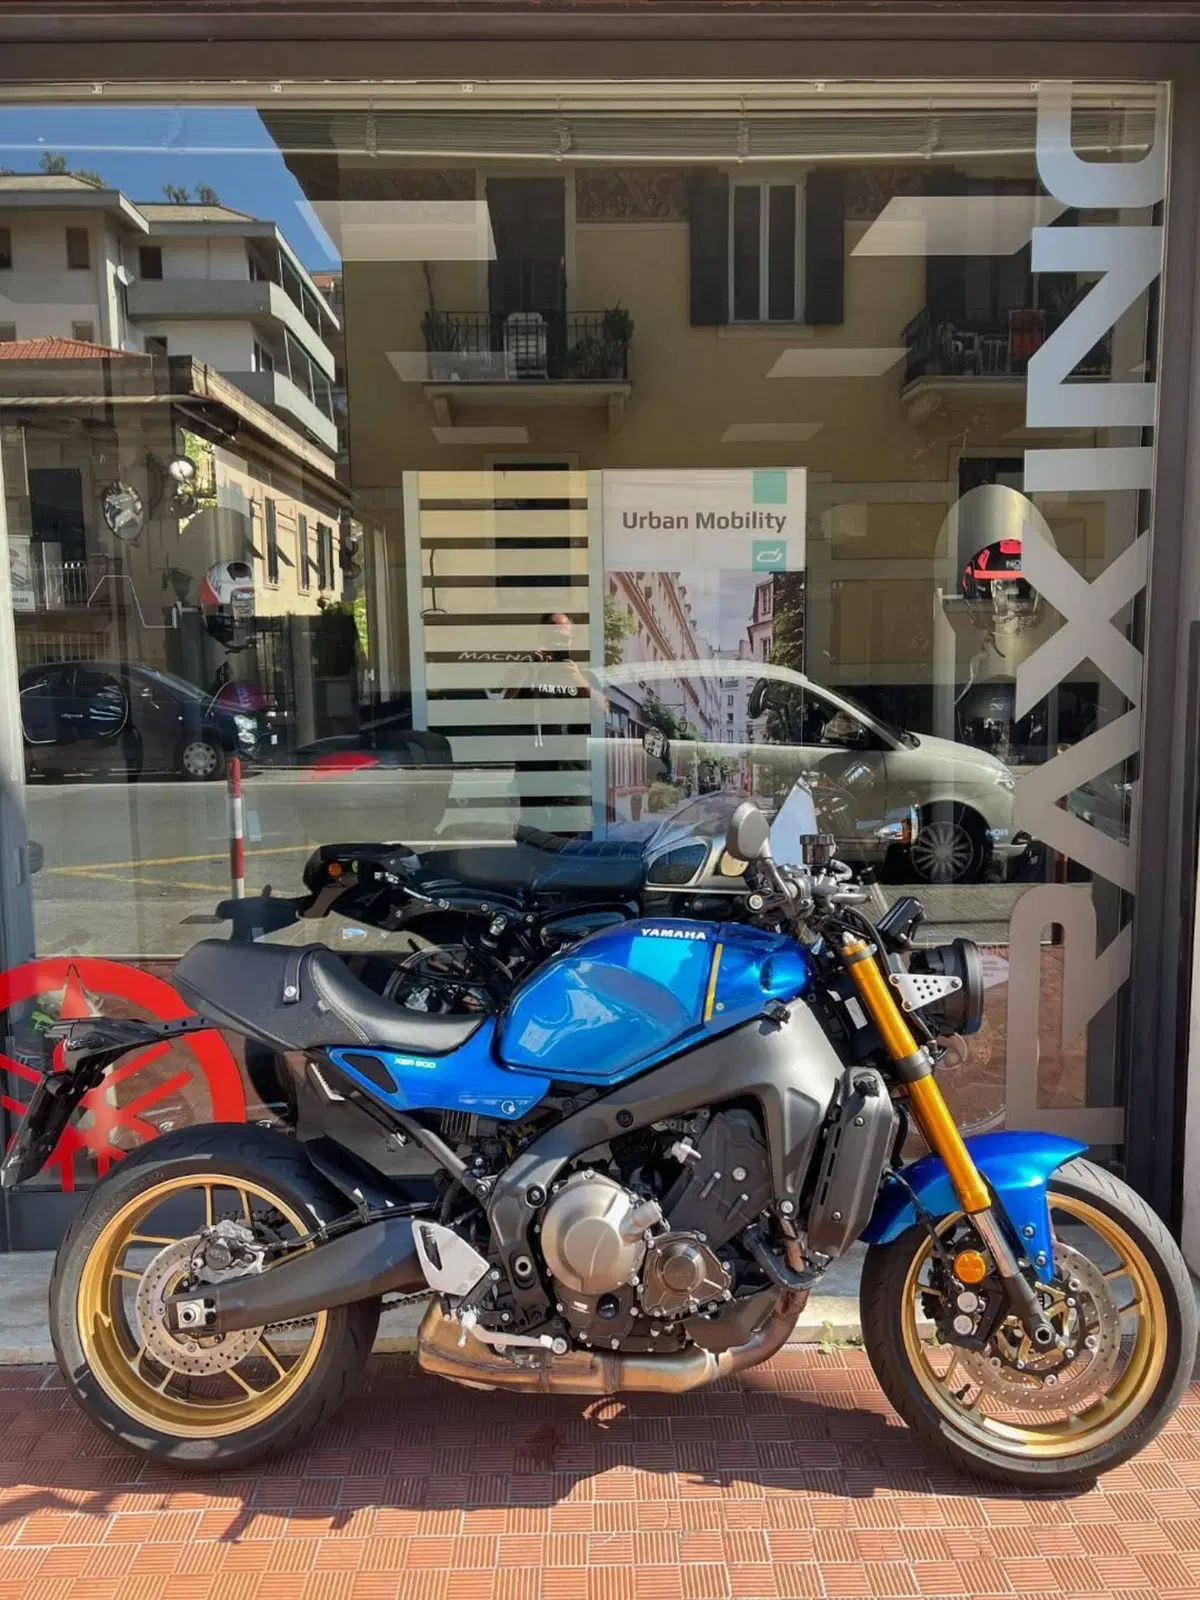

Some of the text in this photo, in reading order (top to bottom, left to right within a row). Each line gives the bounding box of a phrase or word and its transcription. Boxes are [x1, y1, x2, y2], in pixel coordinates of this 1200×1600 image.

[622, 510, 788, 534] Urban Mobility
[458, 651, 533, 662] MACNA
[640, 928, 707, 941] YAMAHA
